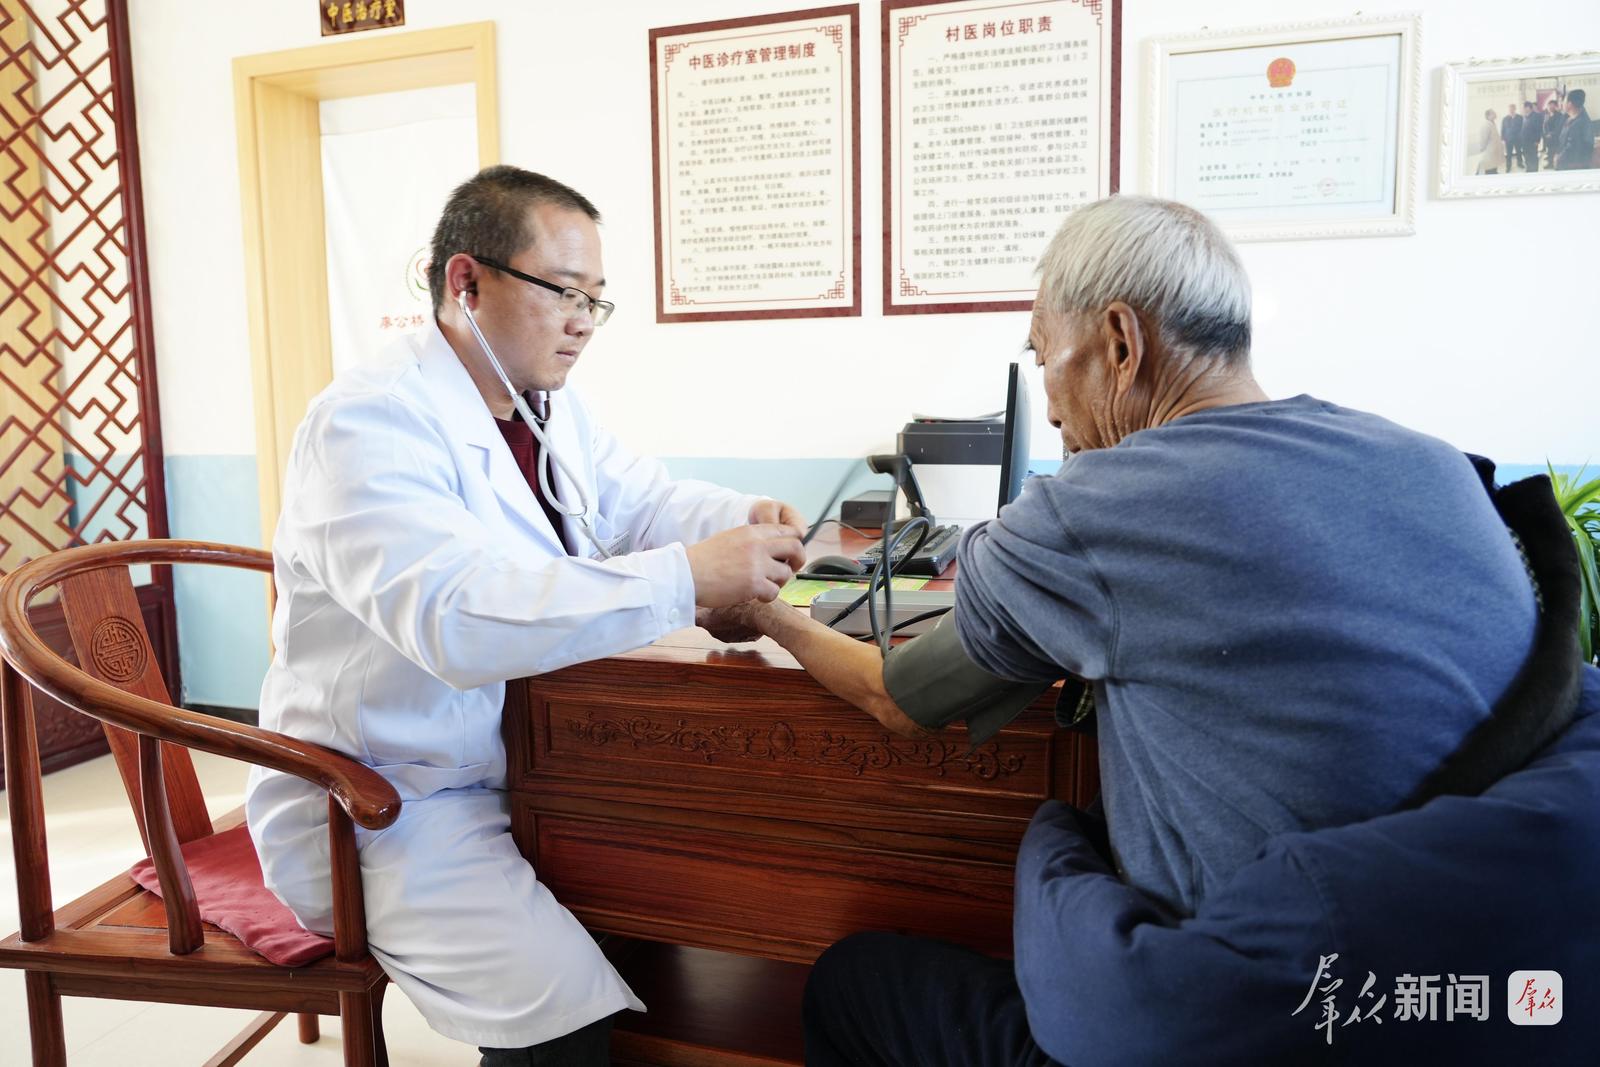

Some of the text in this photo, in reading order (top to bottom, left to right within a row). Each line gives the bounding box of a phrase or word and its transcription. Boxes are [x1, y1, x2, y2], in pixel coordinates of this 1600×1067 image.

[945, 16, 1053, 42] 村医岗位职责
[688, 42, 816, 70] 中医诊疗室管理制度
